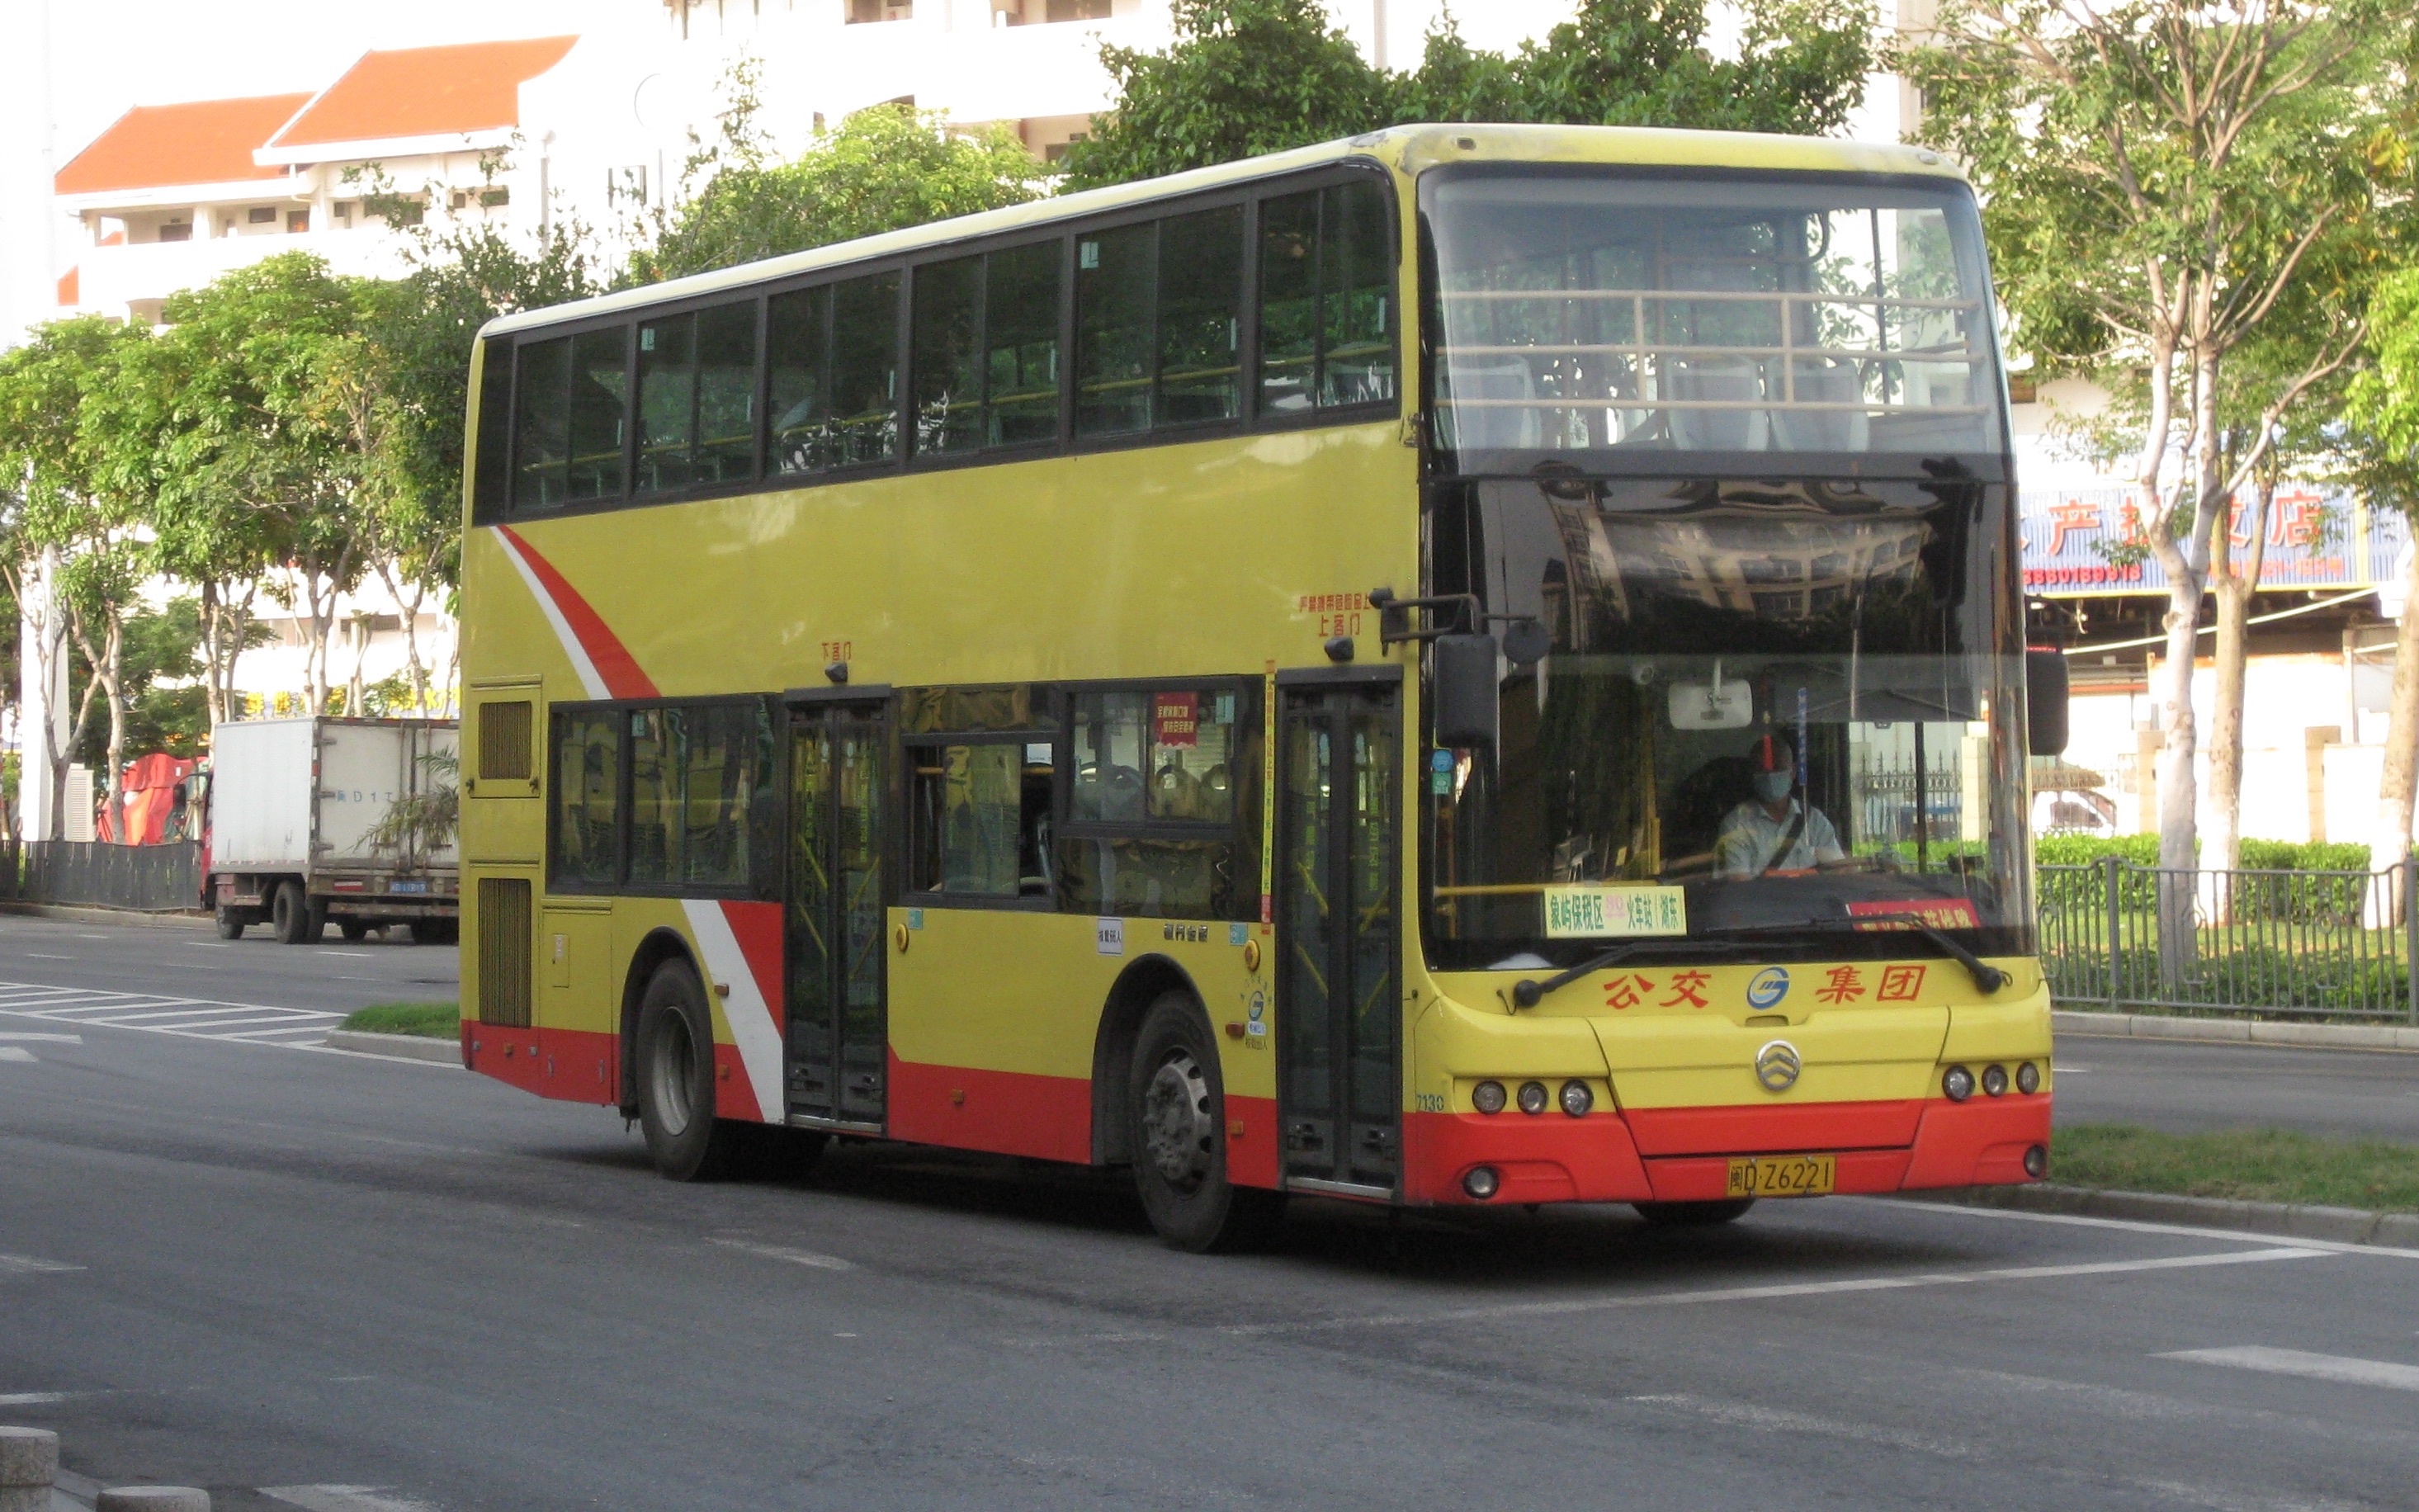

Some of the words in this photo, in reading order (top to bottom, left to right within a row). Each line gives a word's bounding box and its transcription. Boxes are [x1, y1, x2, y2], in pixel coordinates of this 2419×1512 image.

[1319, 613, 1360, 636] 上客门
[822, 641, 851, 661] 下客门
